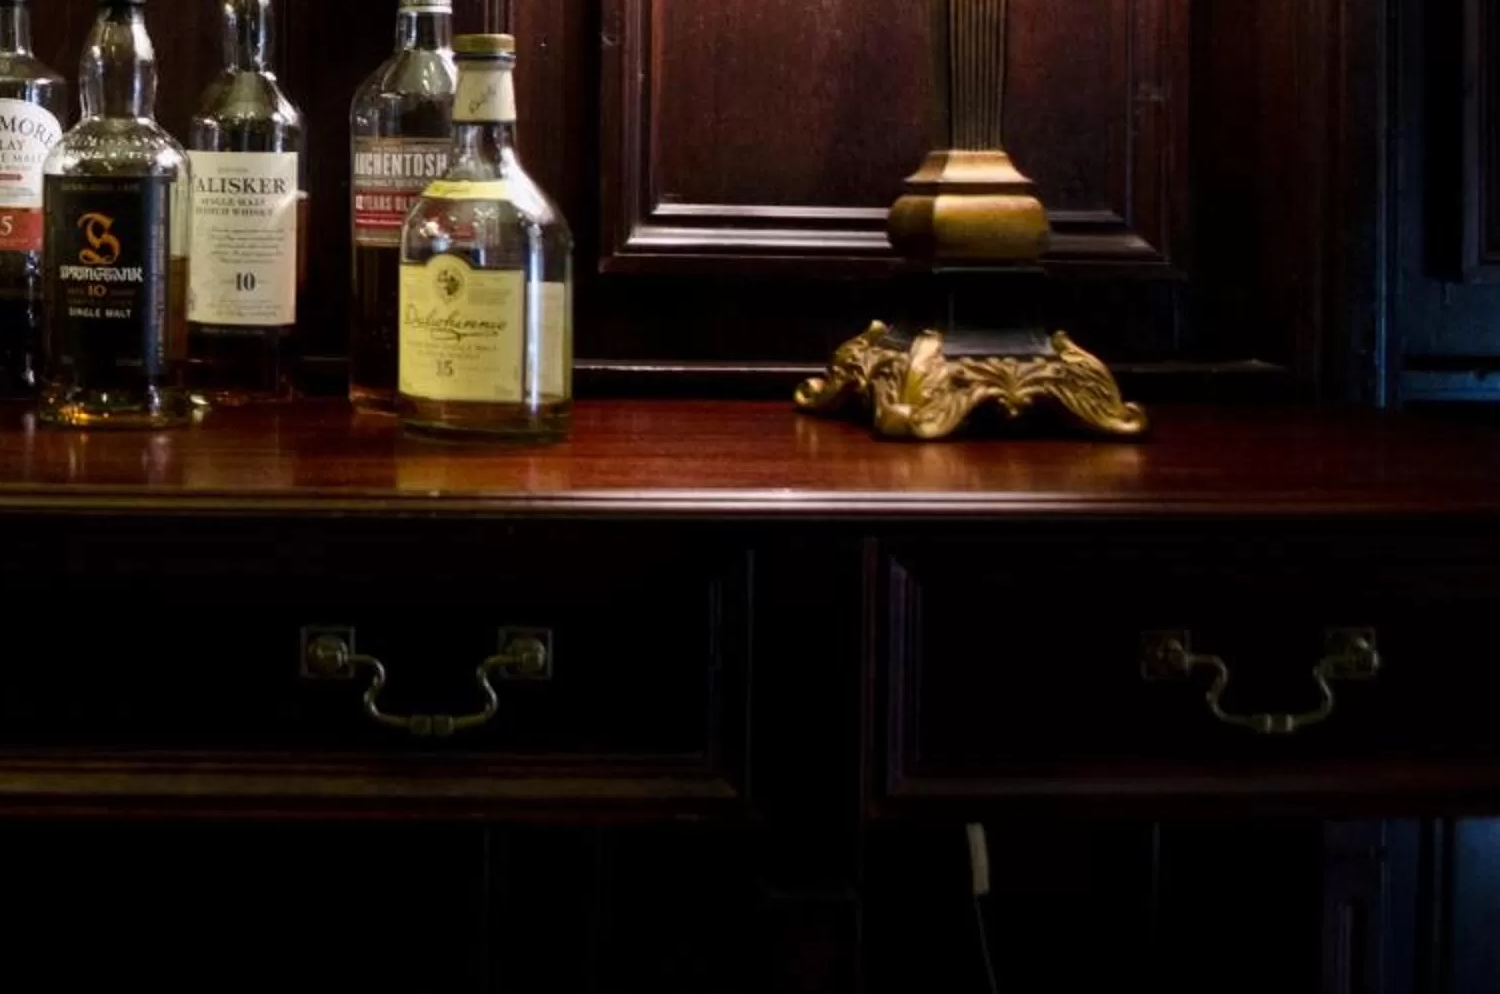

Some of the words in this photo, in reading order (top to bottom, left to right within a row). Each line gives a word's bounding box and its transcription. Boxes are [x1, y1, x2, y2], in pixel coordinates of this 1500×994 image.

[195, 176, 287, 194] ALISKER
[235, 272, 257, 292] 10
[87, 285, 108, 297] 10
[105, 308, 132, 319] MALT
[436, 360, 454, 377] 15
